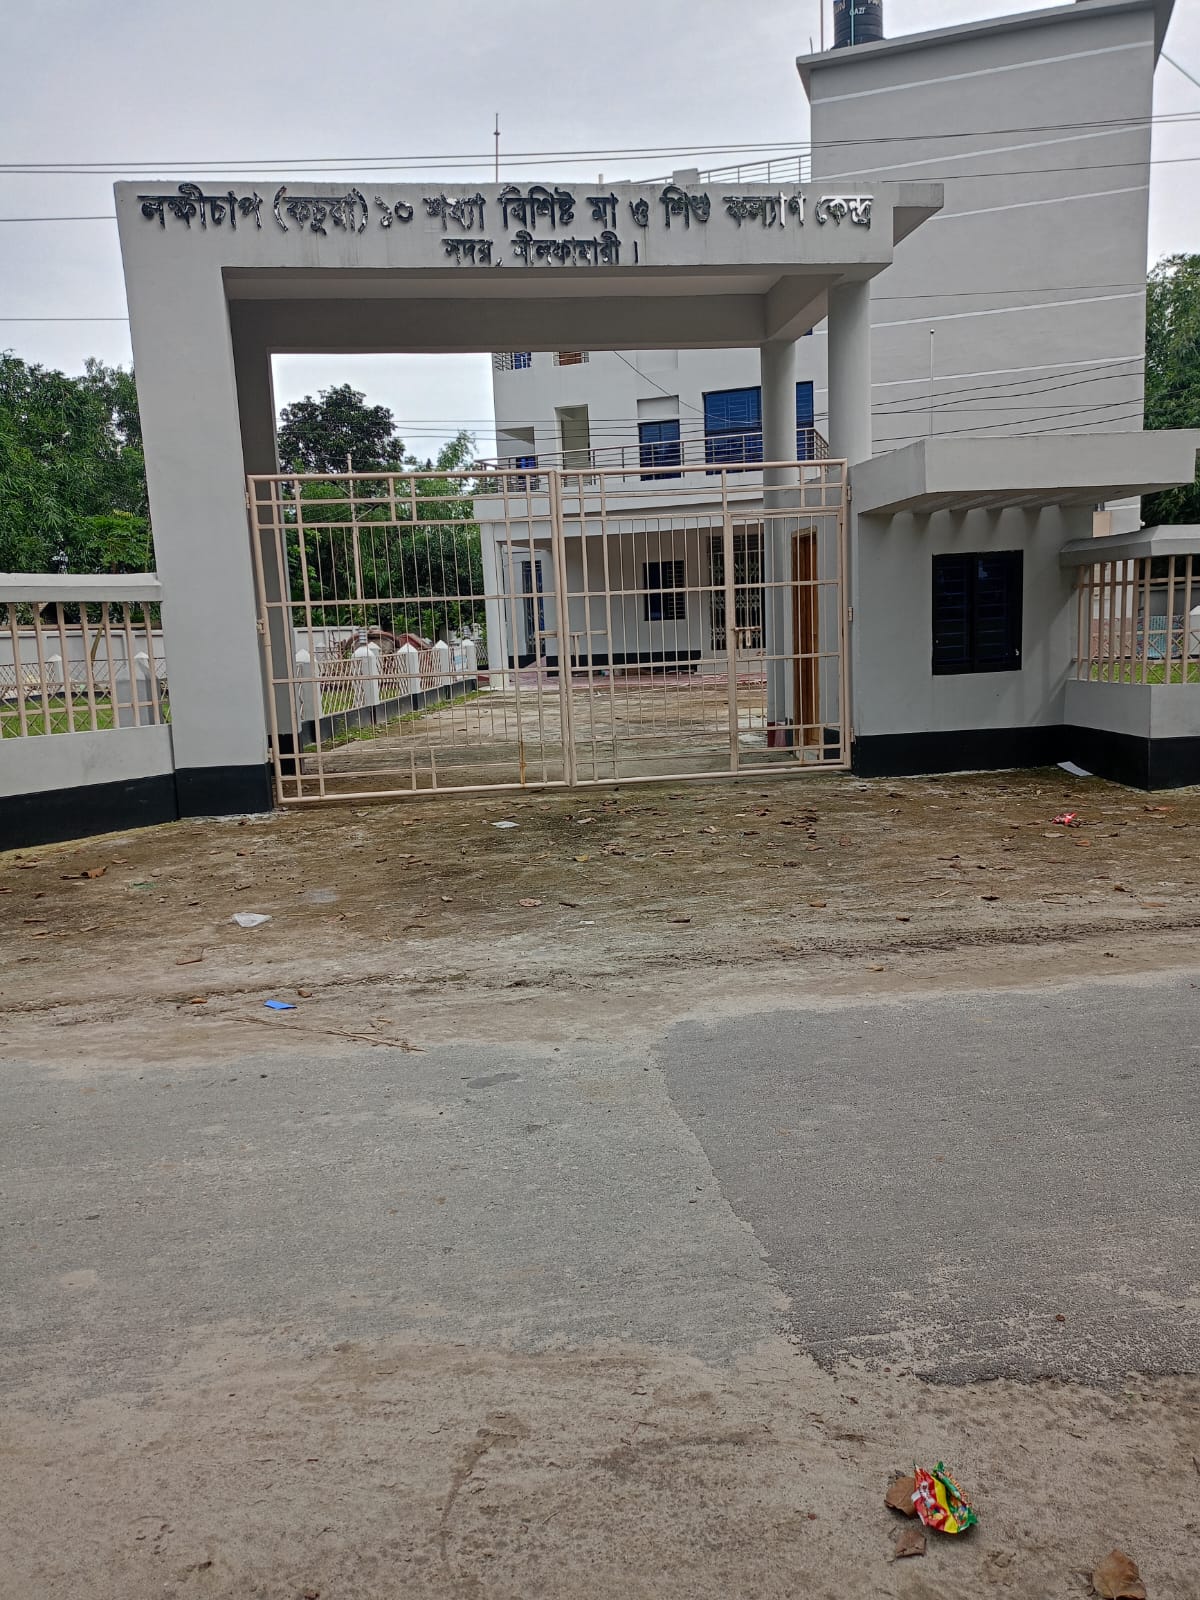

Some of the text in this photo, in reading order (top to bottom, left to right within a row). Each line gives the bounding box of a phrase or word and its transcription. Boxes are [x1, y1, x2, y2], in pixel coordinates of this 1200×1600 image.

[375, 195, 413, 228] ১০
[423, 192, 486, 231] শয্যা
[497, 185, 576, 229] বিশিষ্ট
[586, 192, 619, 229] মা
[628, 197, 649, 226] ও
[659, 185, 711, 228] শিশু
[722, 190, 806, 228] কল্যাণ
[815, 194, 875, 231] কেন্দ্র
